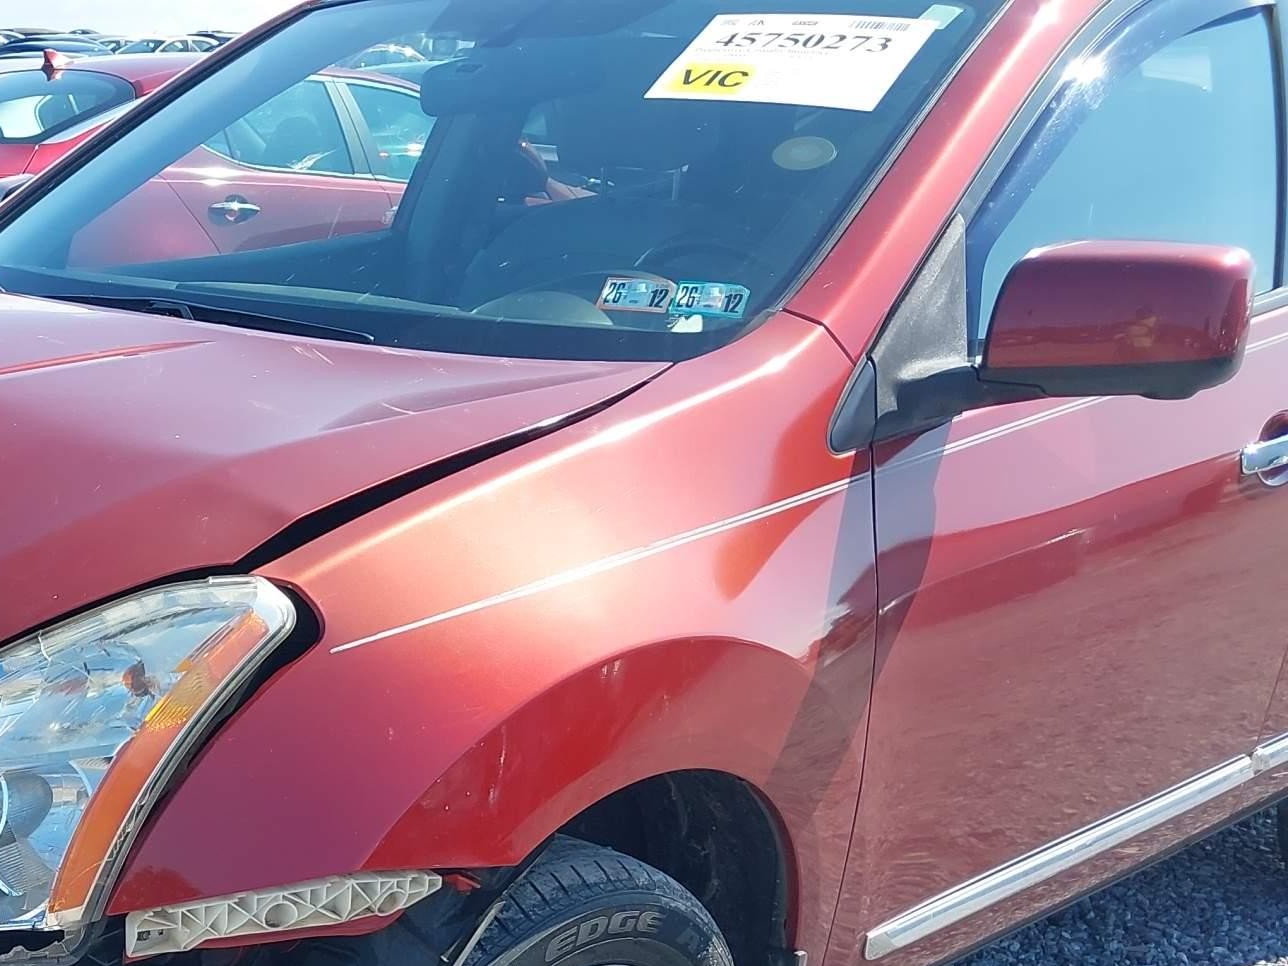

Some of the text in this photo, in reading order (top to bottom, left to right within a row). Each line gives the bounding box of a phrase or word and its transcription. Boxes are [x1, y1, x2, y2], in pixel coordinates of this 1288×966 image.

[715, 32, 892, 53] 45750273
[682, 69, 749, 88] VIC
[603, 282, 670, 308] 26 12
[676, 286, 744, 314] 26 12
[545, 911, 665, 962] EDGE
